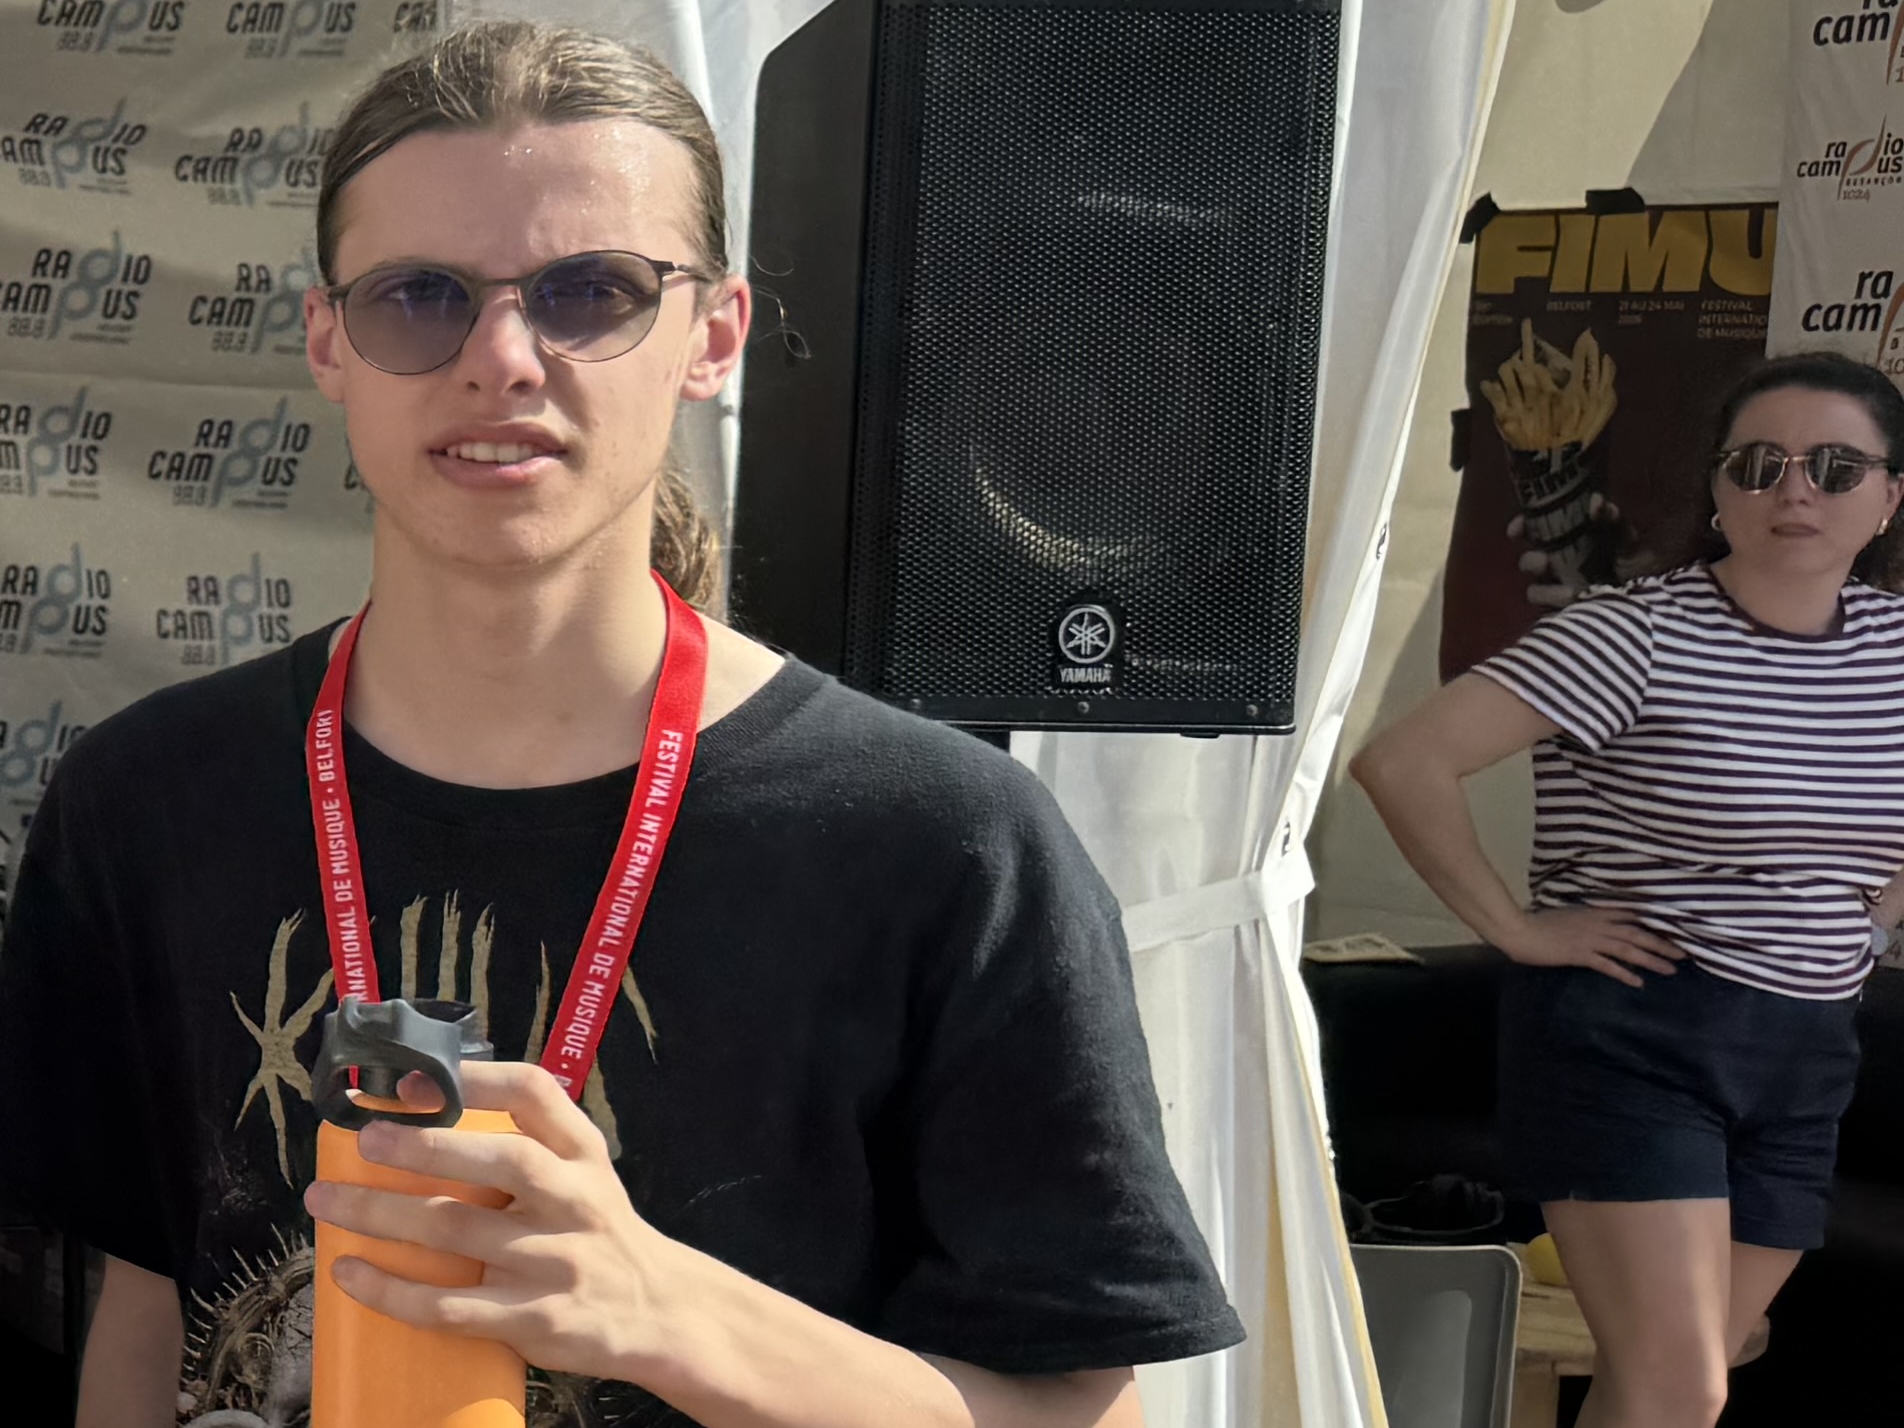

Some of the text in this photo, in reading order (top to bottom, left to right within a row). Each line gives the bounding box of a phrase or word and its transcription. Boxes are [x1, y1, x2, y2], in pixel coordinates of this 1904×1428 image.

[1475, 207, 1779, 296] FIMU
[1060, 667, 1111, 683] YAMAHA
[322, 798, 351, 875] MUSIQUE
[333, 879, 354, 902] DE
[561, 729, 684, 1060] FESTIVAL INTERNATIONAL DE MUSIQUE
